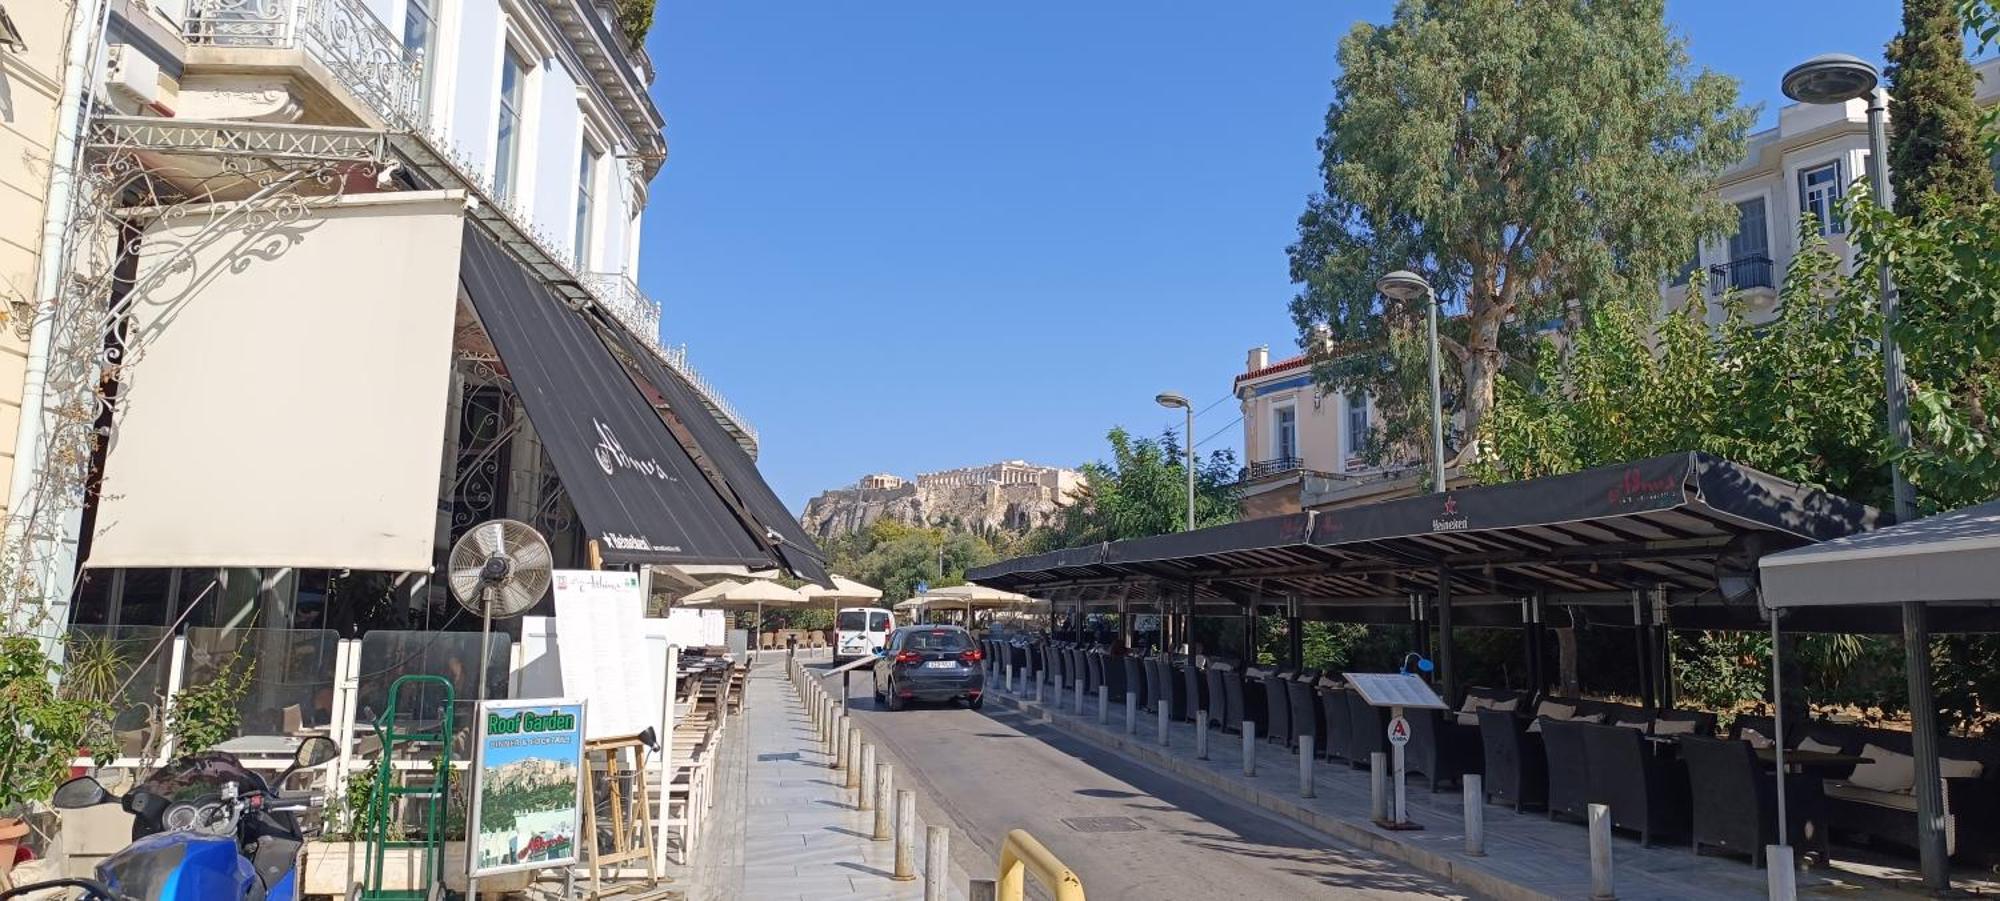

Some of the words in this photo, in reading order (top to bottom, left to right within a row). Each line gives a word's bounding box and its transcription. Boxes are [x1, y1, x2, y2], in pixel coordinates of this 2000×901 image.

[1432, 518, 1468, 531] Heineken
[488, 712, 522, 735] Roof
[523, 710, 575, 732] Garden
